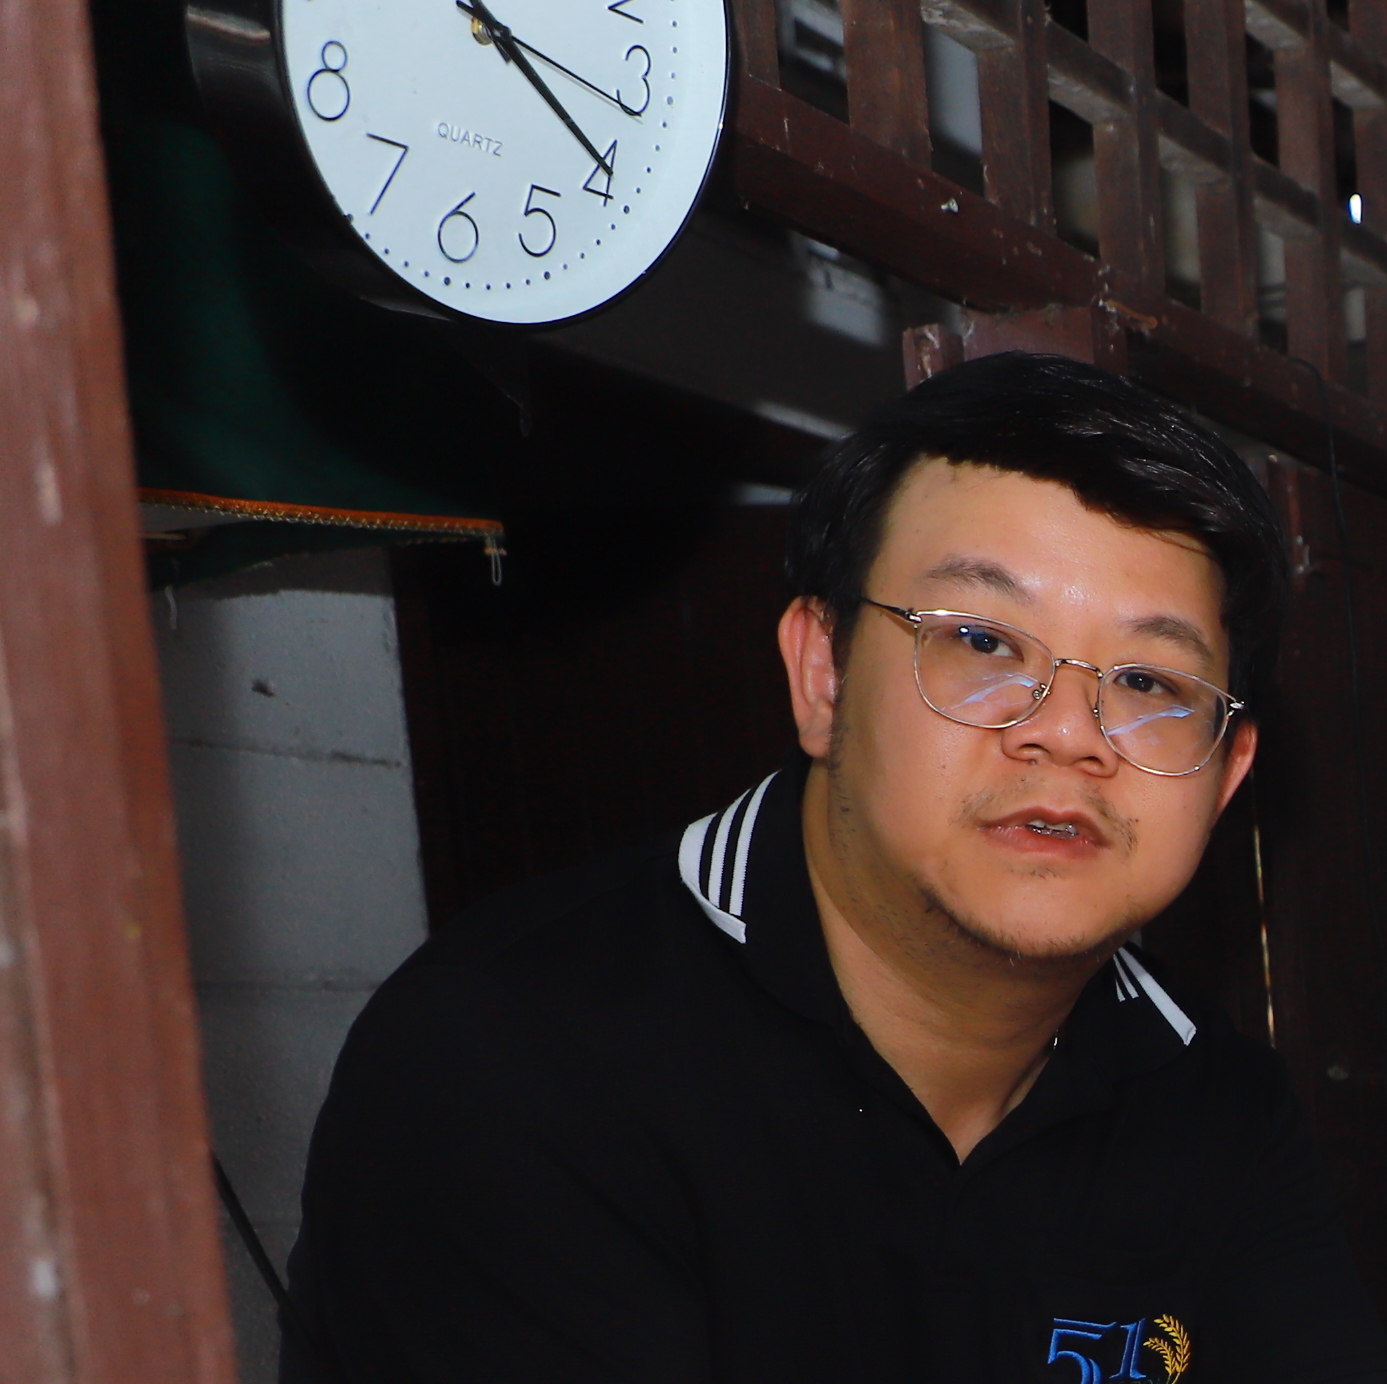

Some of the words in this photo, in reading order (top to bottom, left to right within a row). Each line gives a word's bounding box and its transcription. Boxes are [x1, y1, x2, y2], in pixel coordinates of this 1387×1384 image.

[307, 40, 350, 121] 8
[617, 44, 651, 116] 3
[366, 133, 409, 215] 7
[437, 122, 503, 157] QUARTZ
[583, 139, 617, 207] 4
[438, 192, 479, 262] 6
[519, 184, 561, 257] 5
